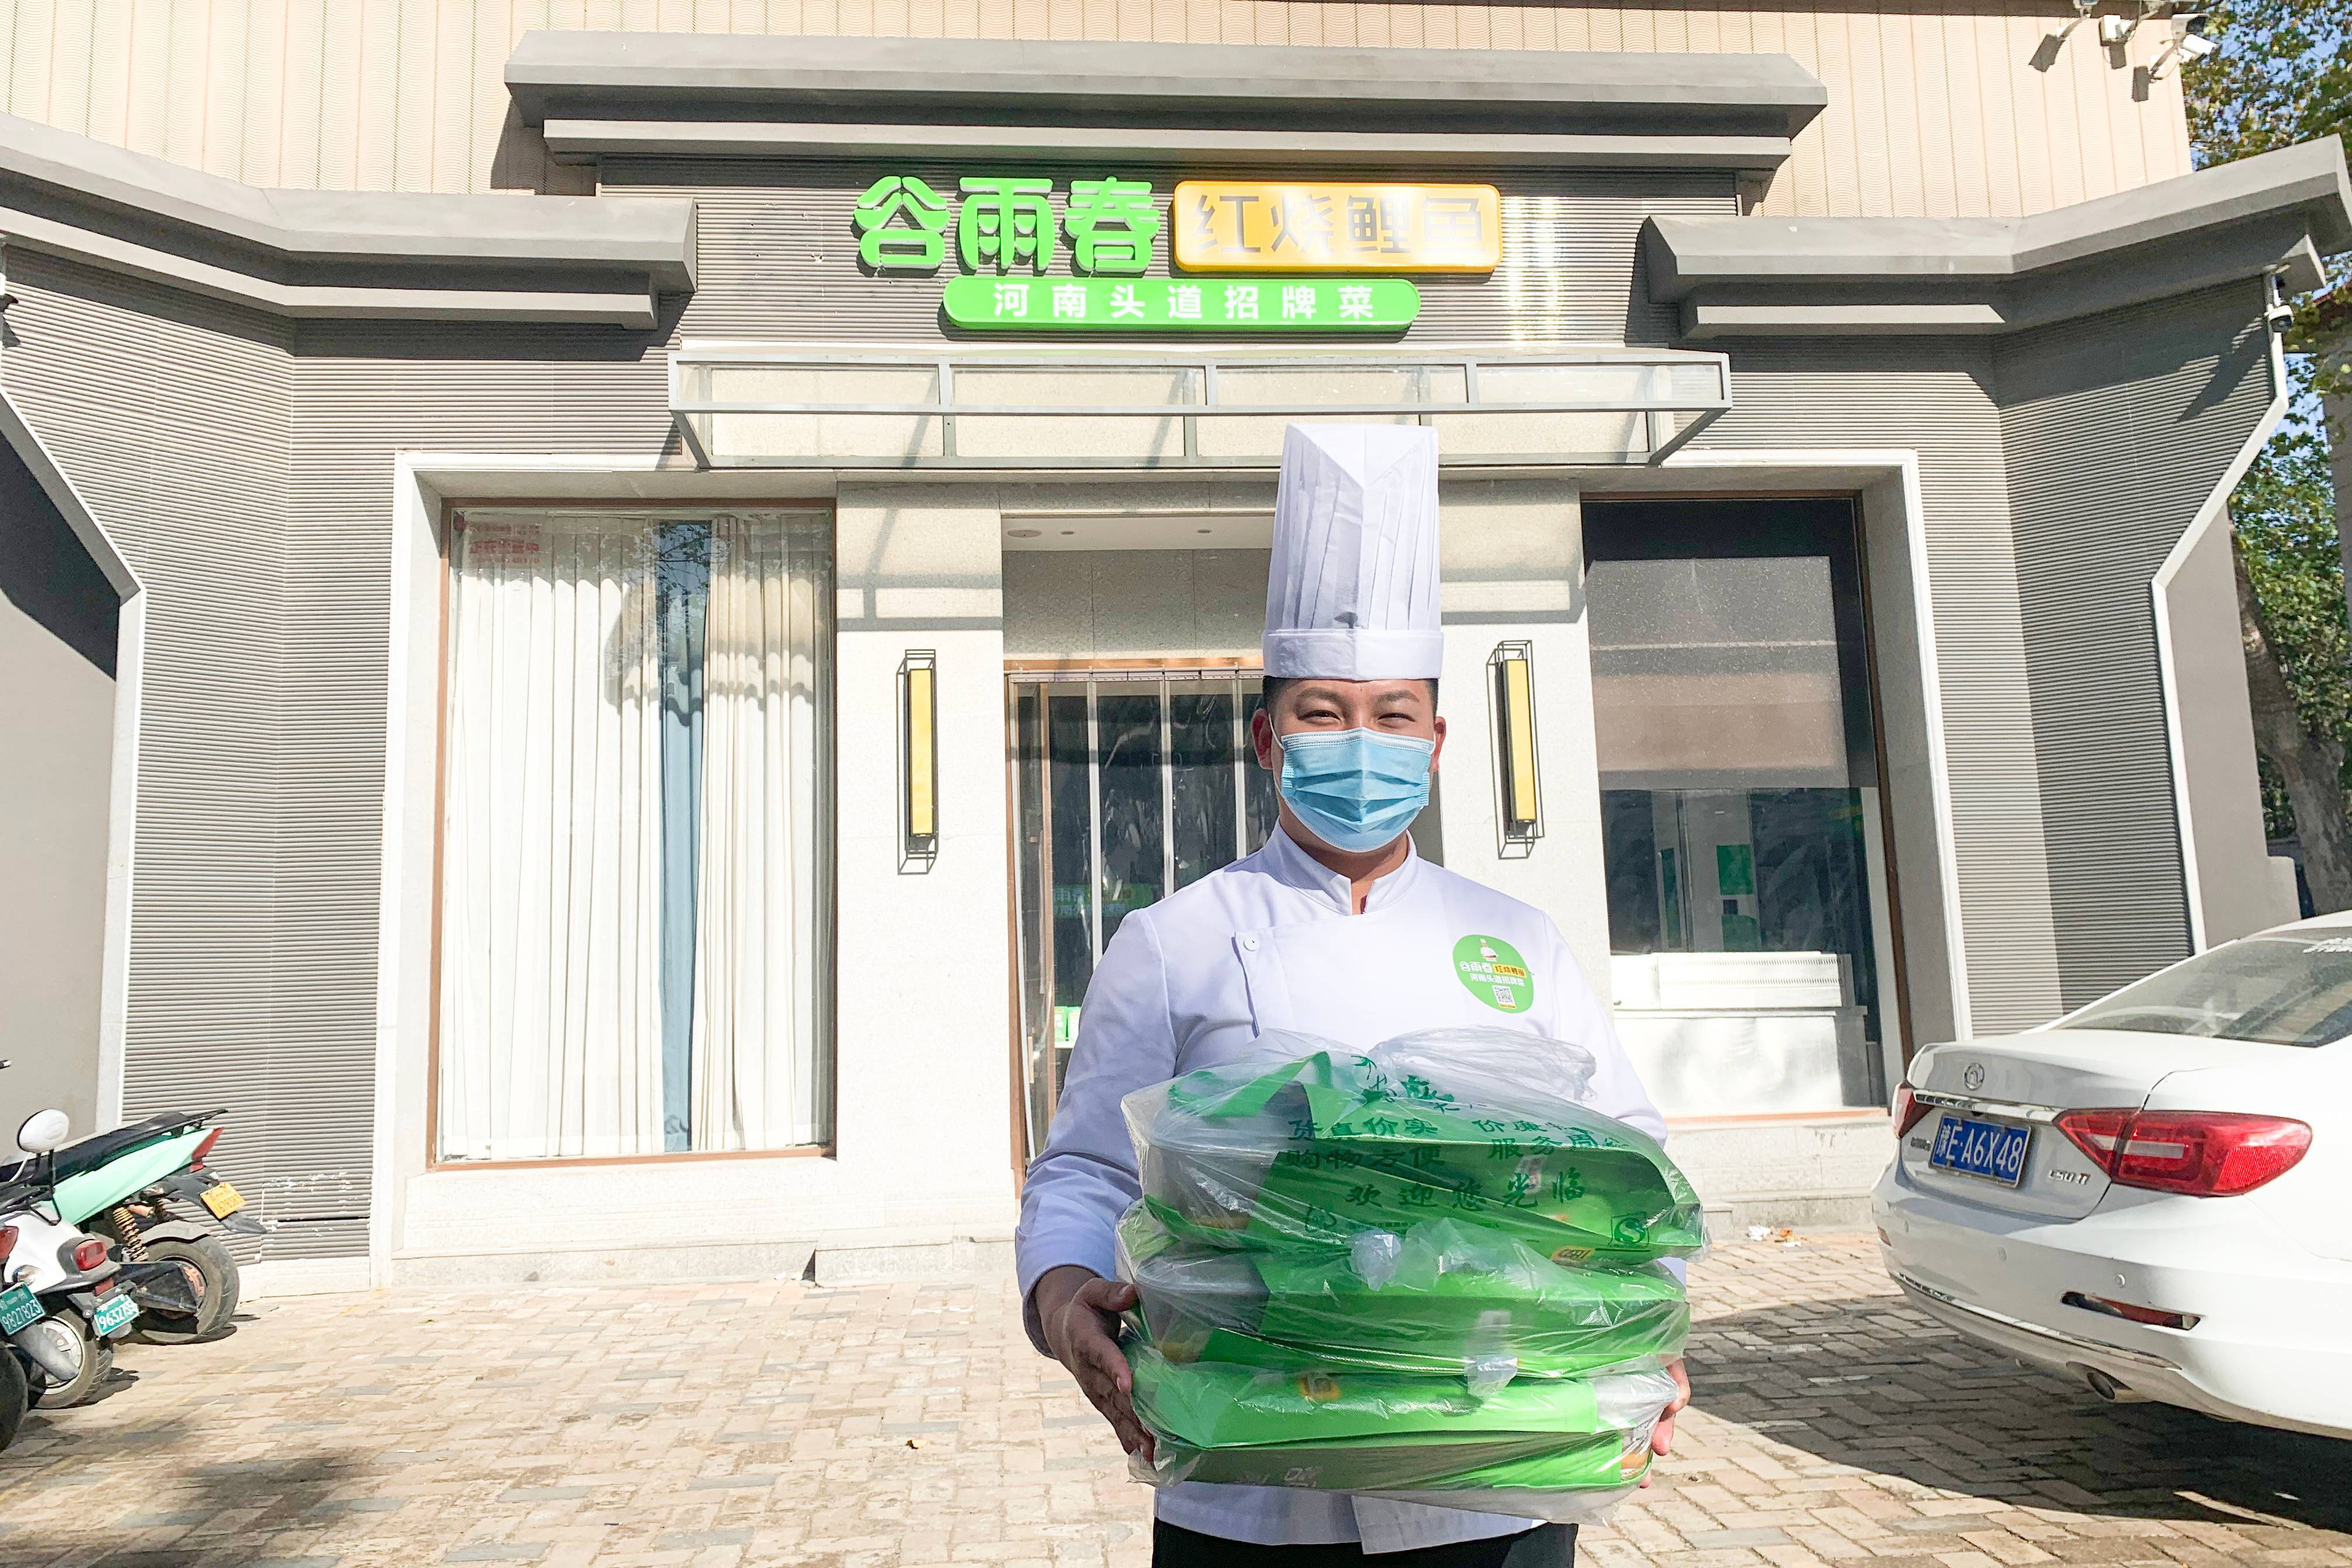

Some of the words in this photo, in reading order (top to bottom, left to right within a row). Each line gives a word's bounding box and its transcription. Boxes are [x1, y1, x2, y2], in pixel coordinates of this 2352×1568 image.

[854, 176, 1160, 272] 谷雨春
[1194, 194, 1486, 254] 红烧鲤鱼
[993, 284, 1373, 320] 河南头道招牌菜
[1346, 1167, 1585, 1212] 欢迎您光临
[2, 1299, 41, 1329] 9827823
